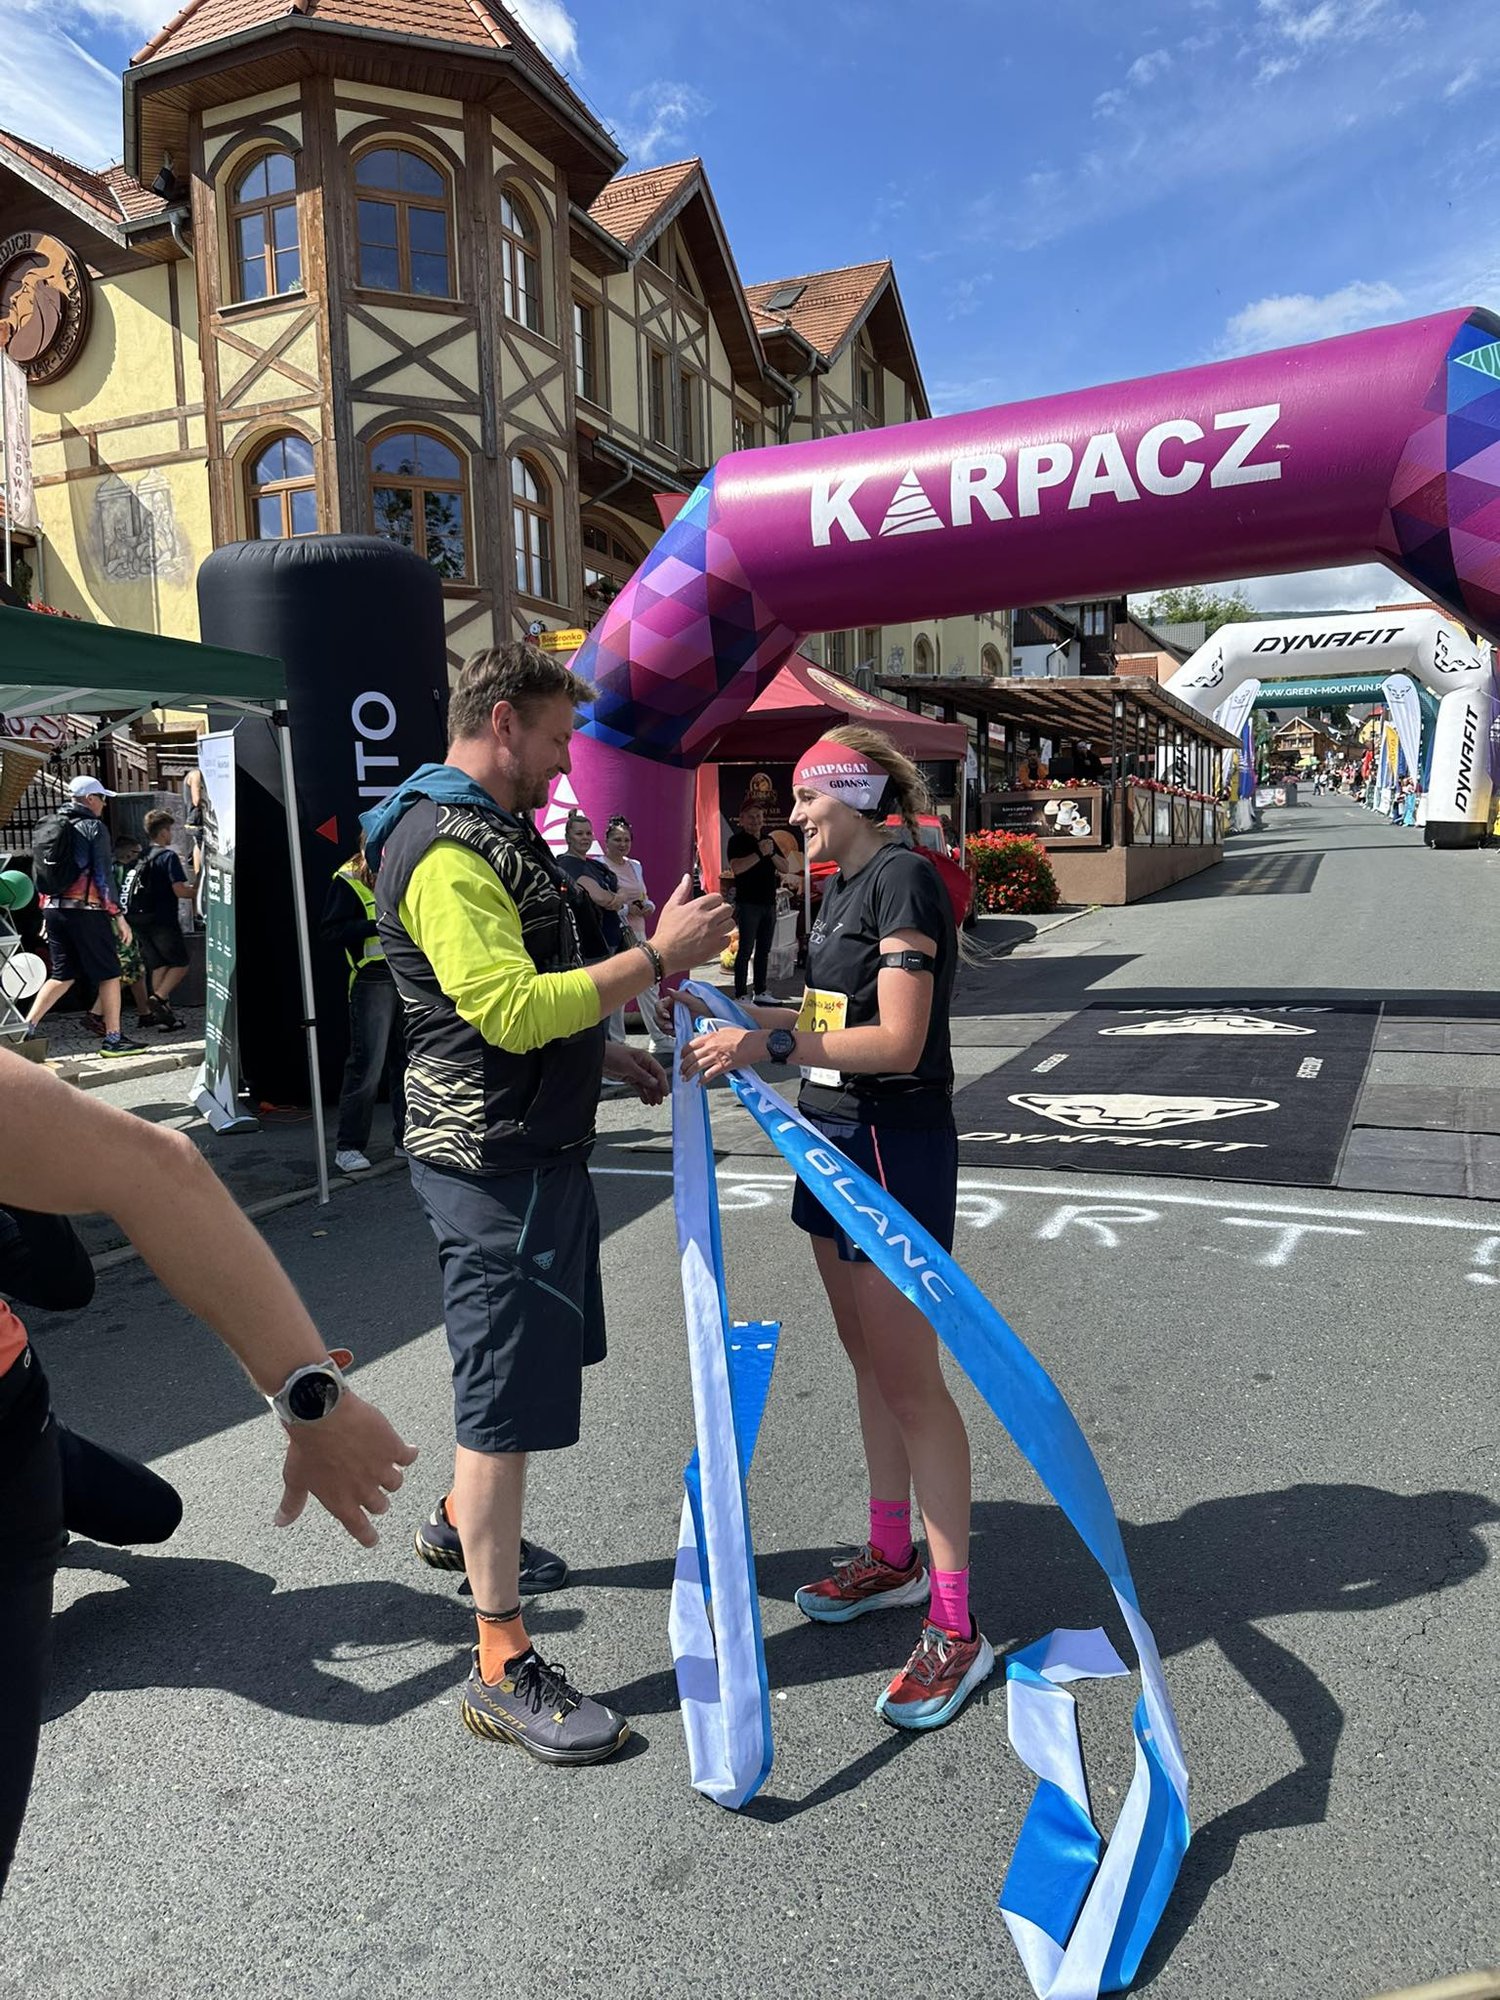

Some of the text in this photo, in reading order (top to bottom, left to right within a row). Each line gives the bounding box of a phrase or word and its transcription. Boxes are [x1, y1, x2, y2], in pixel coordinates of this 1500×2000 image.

[809, 403, 1282, 547] KARPACZ
[540, 632, 583, 643] Biedronka
[1252, 627, 1405, 655] DYNAFIT
[1256, 683, 1382, 698] WWW.GREEN-MOUNTAIN.P
[800, 763, 869, 779] HARPAGAN
[1454, 704, 1479, 814] DYNAFIT
[956, 1131, 1269, 1152] DYNAFIT
[804, 1148, 956, 1303] BLANC
[472, 1683, 528, 1729] DYNAFIT
